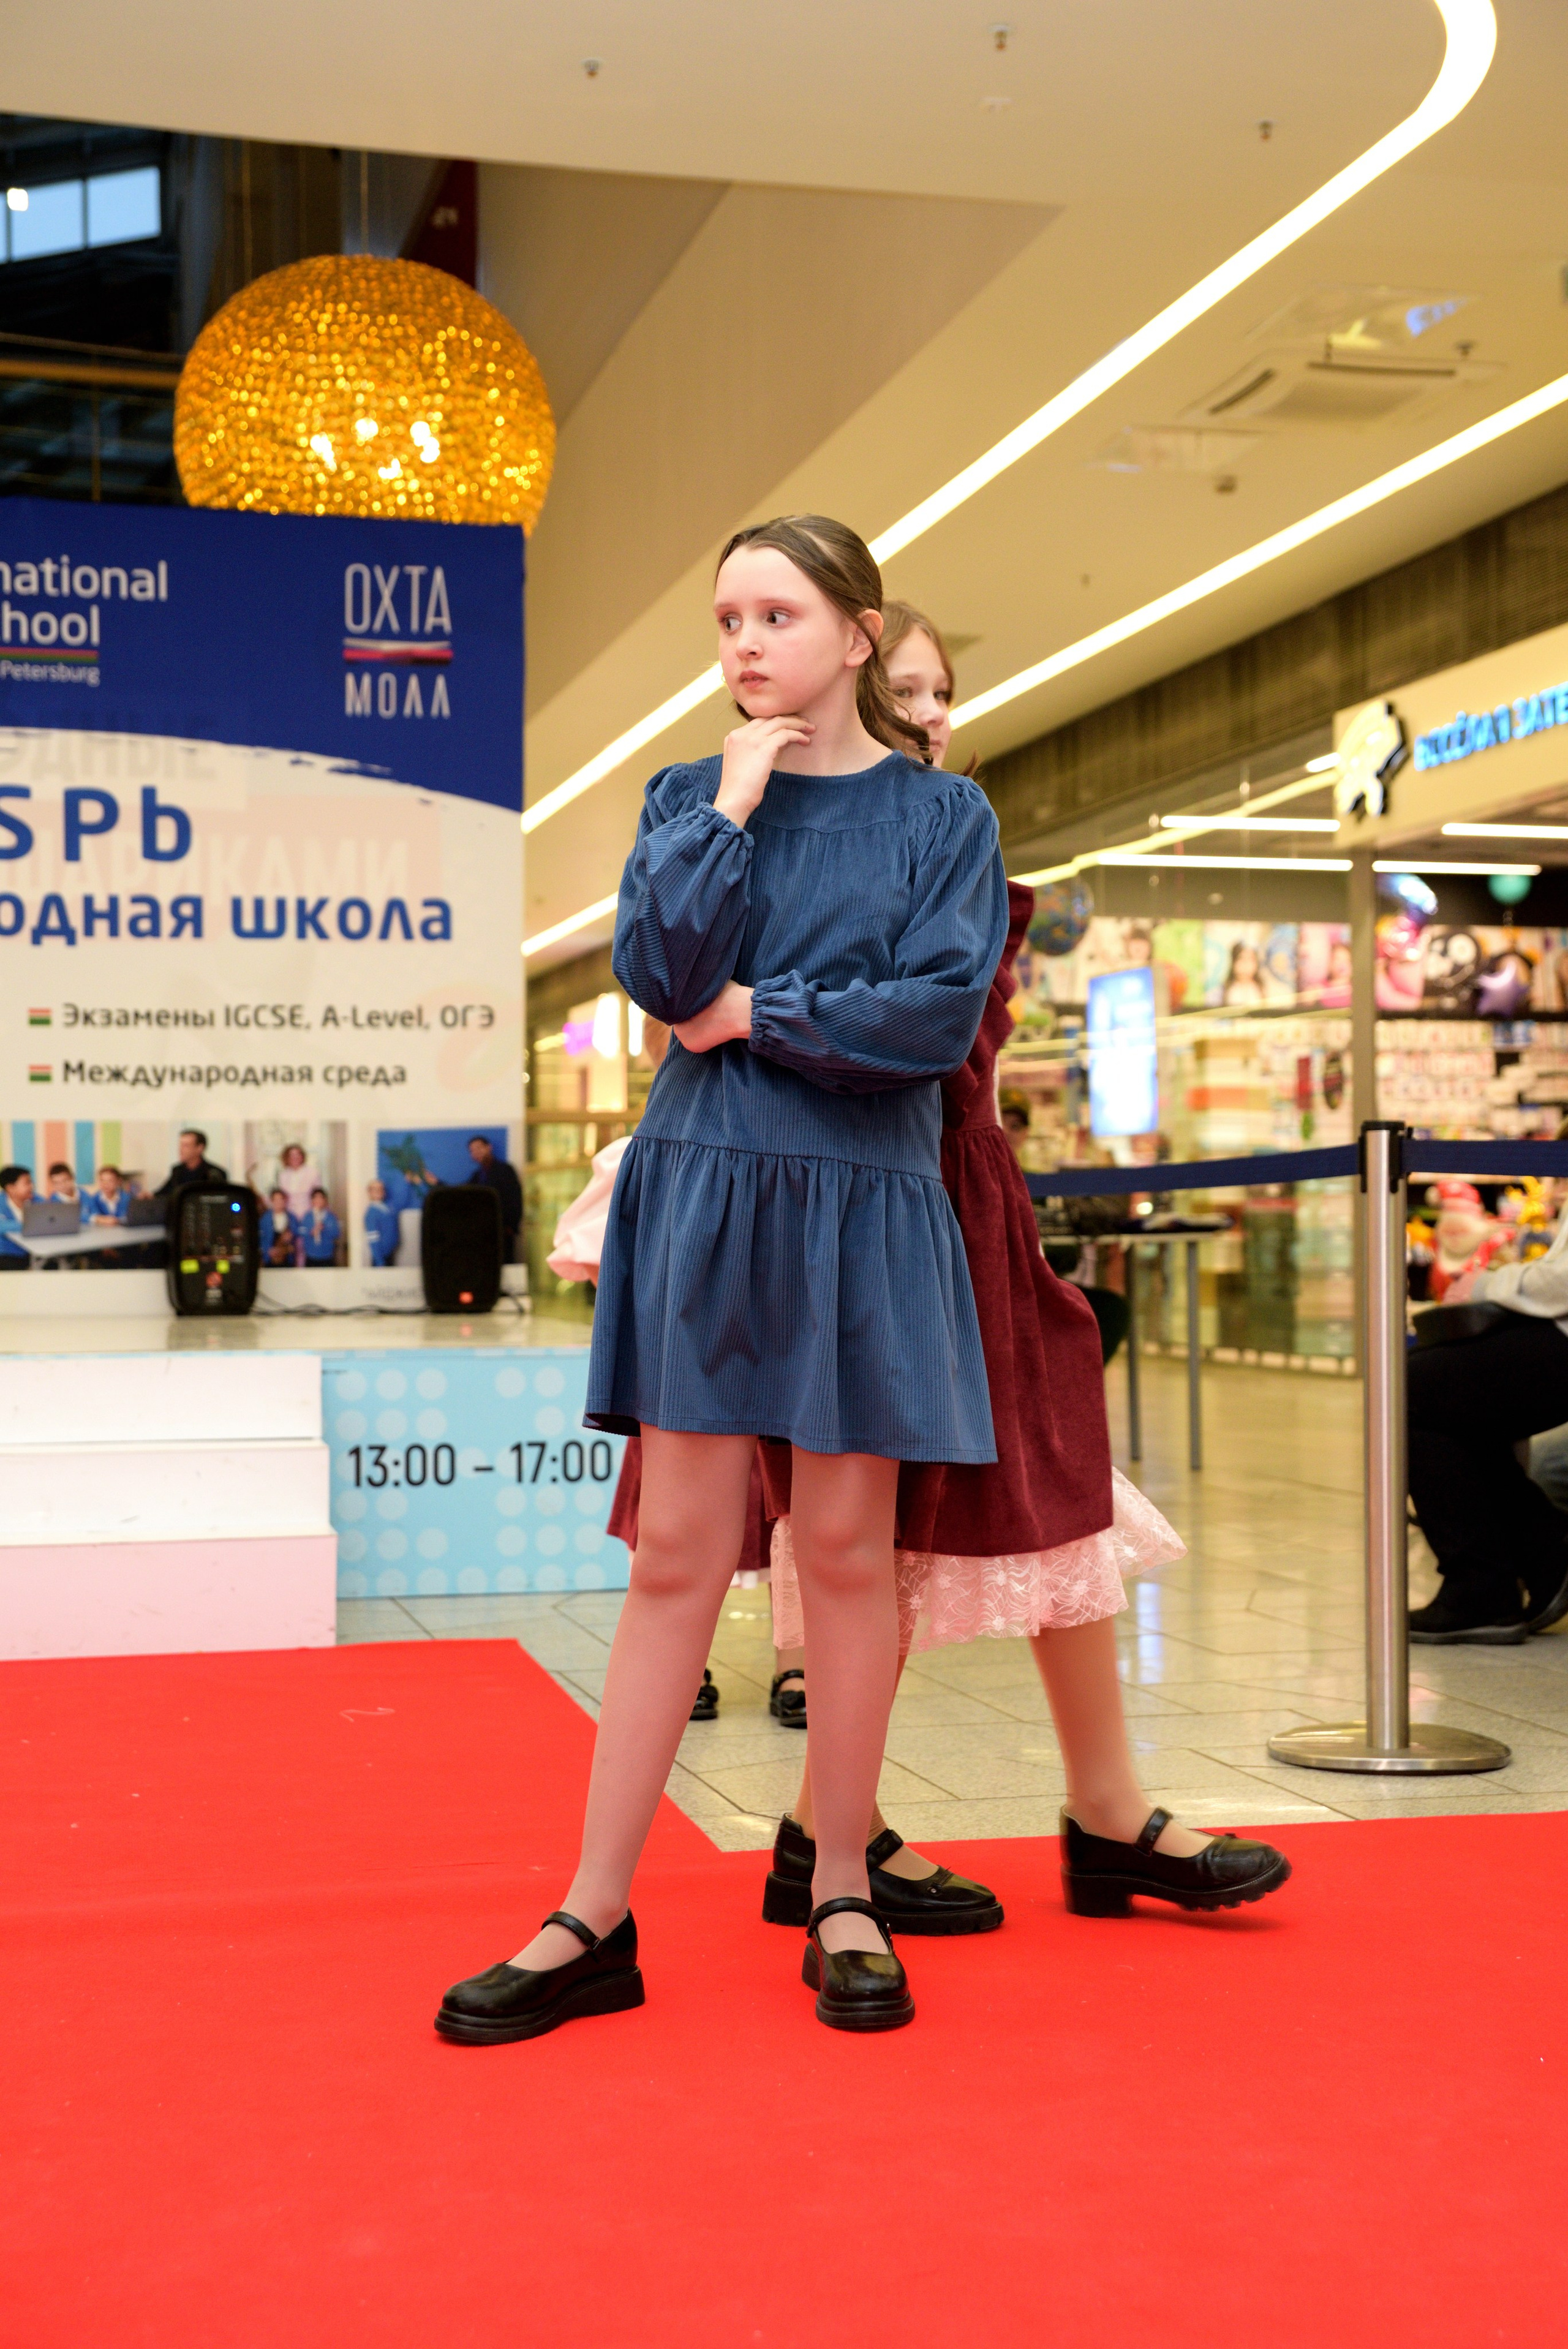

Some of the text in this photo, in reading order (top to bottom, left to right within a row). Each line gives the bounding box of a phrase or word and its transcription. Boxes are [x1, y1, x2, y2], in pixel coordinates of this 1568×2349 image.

[344, 562, 452, 635] ОХТА
[2, 600, 100, 647] hool
[0, 660, 100, 687] Petersburg
[345, 672, 451, 719] МОЛЛ
[0, 892, 452, 946] одная школа
[62, 1003, 495, 1030] Экзамены IGCSE, A-Level, ОГЭ
[63, 1060, 407, 1089] Международная среда
[349, 1443, 456, 1488] 13:00
[510, 1440, 611, 1484] 17:00
